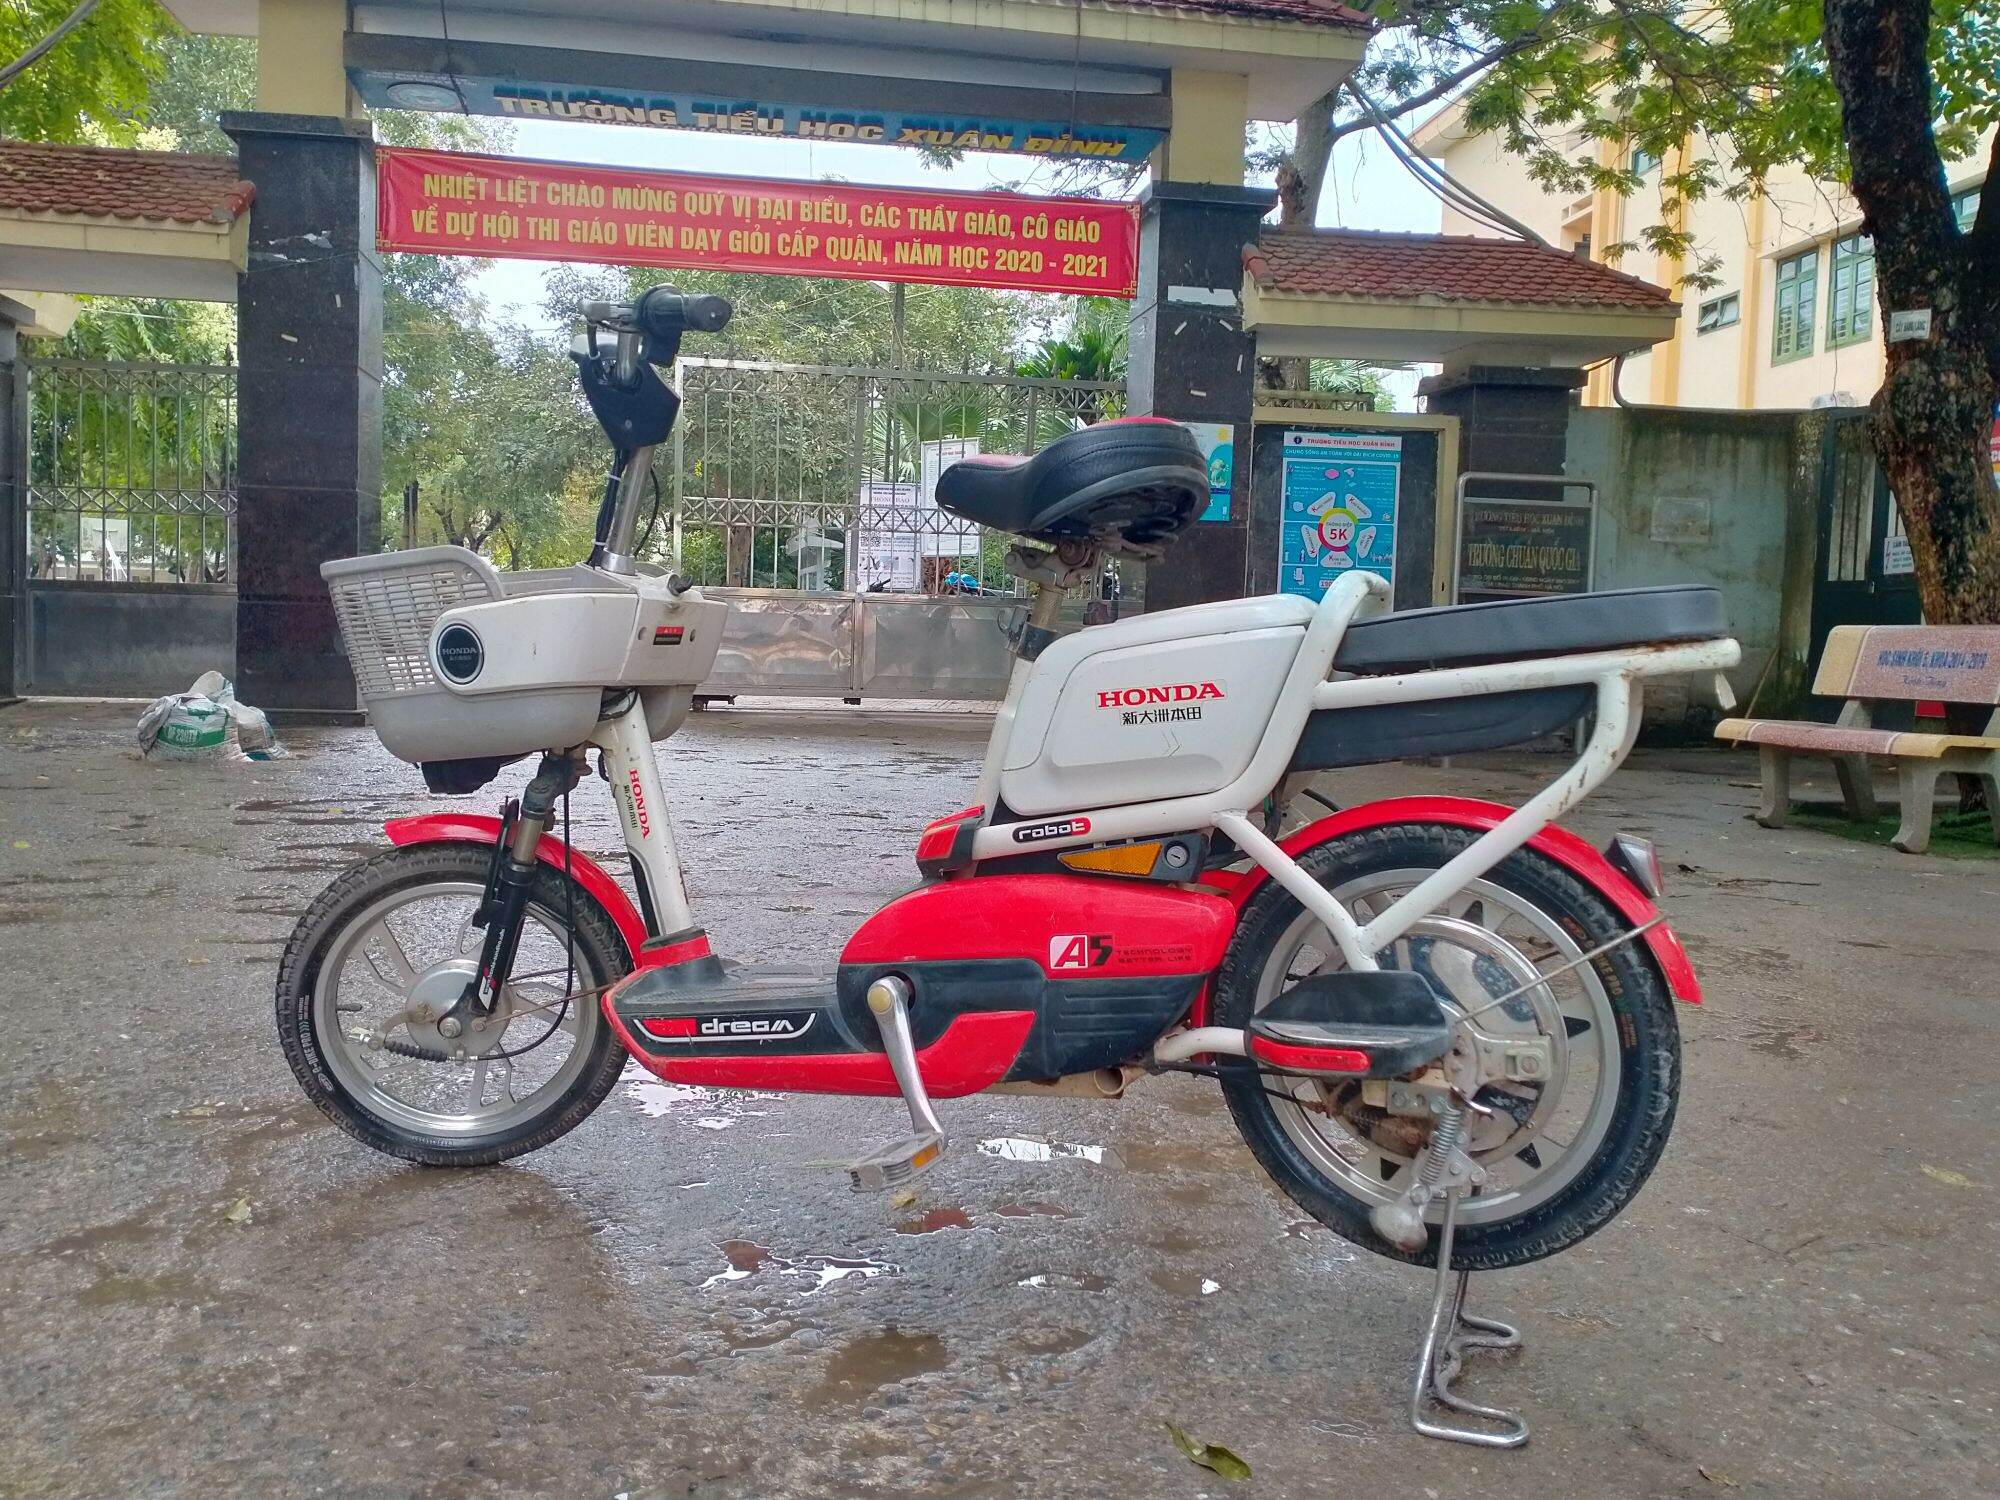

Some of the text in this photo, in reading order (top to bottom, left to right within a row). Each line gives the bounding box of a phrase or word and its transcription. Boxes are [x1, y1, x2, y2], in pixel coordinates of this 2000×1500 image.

[692, 109, 784, 134] TIỂU
[898, 128, 1013, 150] XUÂN
[424, 172, 1100, 243] NHIỆT LIỆT CHÀO MỪNG QUÝ VỊ ĐẠI BIỂU, CÁC THẦY GIÁO, CÔ GIÁO
[411, 203, 439, 234] VỀ
[445, 211, 478, 241] DỰ
[482, 210, 519, 243] HỘI
[526, 216, 560, 242] THI
[567, 216, 618, 245] GIÁO
[624, 220, 674, 248] VIÊN
[680, 226, 723, 255] DẠY
[728, 223, 770, 255] GIỎI
[777, 226, 819, 258] CẤP
[826, 234, 888, 266] QUẬN,
[894, 237, 942, 266] NĂM
[948, 245, 989, 273] HỌC
[994, 248, 1043, 273] 2020
[1062, 253, 1107, 278] 2021
[1329, 528, 1348, 540] 5K
[442, 646, 477, 655] HONDA
[1097, 682, 1225, 708] HONDA
[1122, 706, 1202, 726] 新大洲本田
[629, 768, 651, 840] HONDA
[1018, 820, 1086, 840] robot
[300, 1032, 313, 1048] PRO
